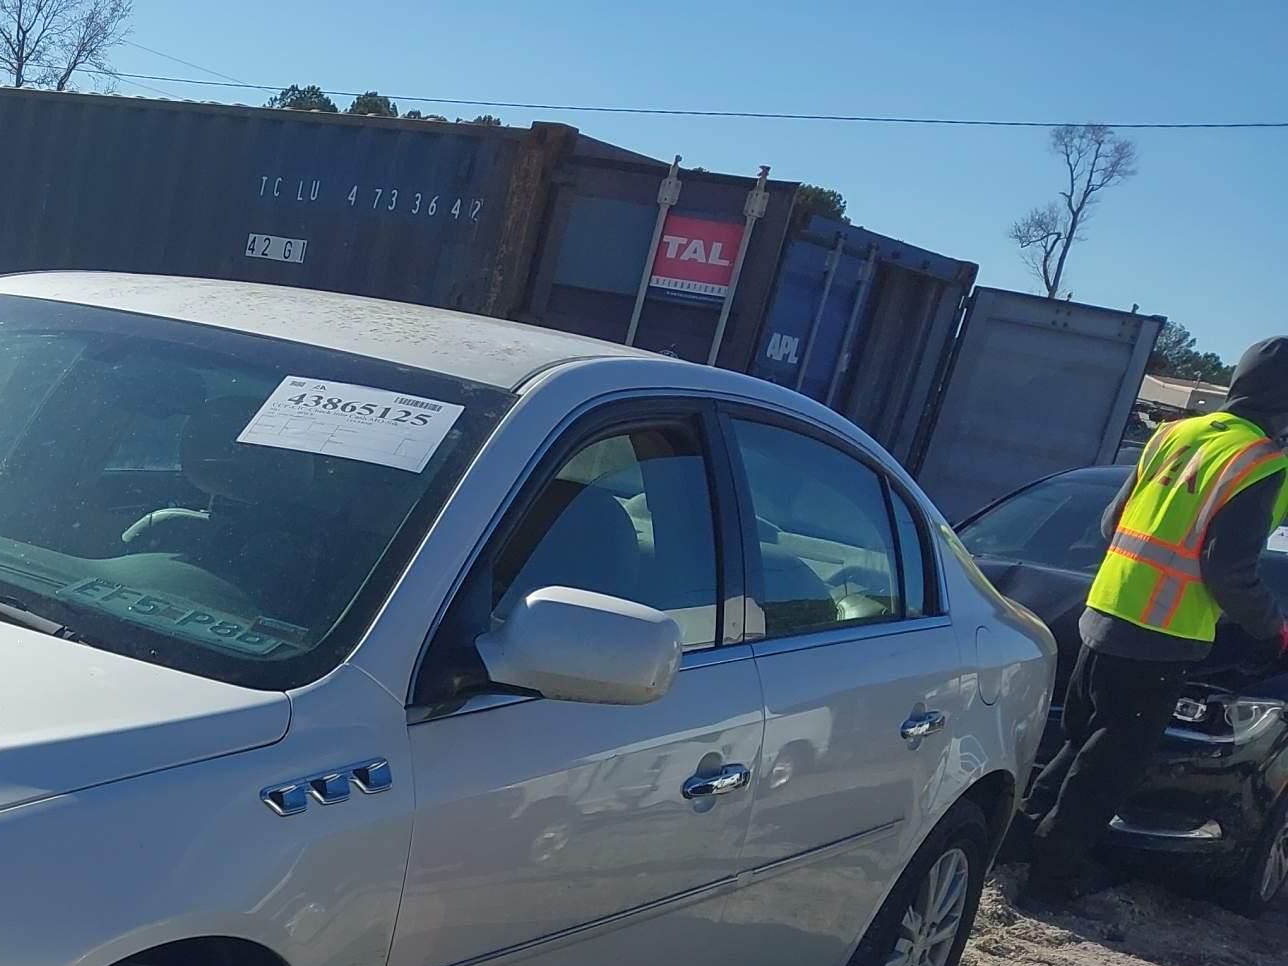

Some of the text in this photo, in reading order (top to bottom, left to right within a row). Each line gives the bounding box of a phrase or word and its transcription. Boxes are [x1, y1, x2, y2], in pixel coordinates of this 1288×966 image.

[662, 234, 730, 266] TAL
[766, 332, 800, 364] APL
[287, 392, 433, 426] 43865125
